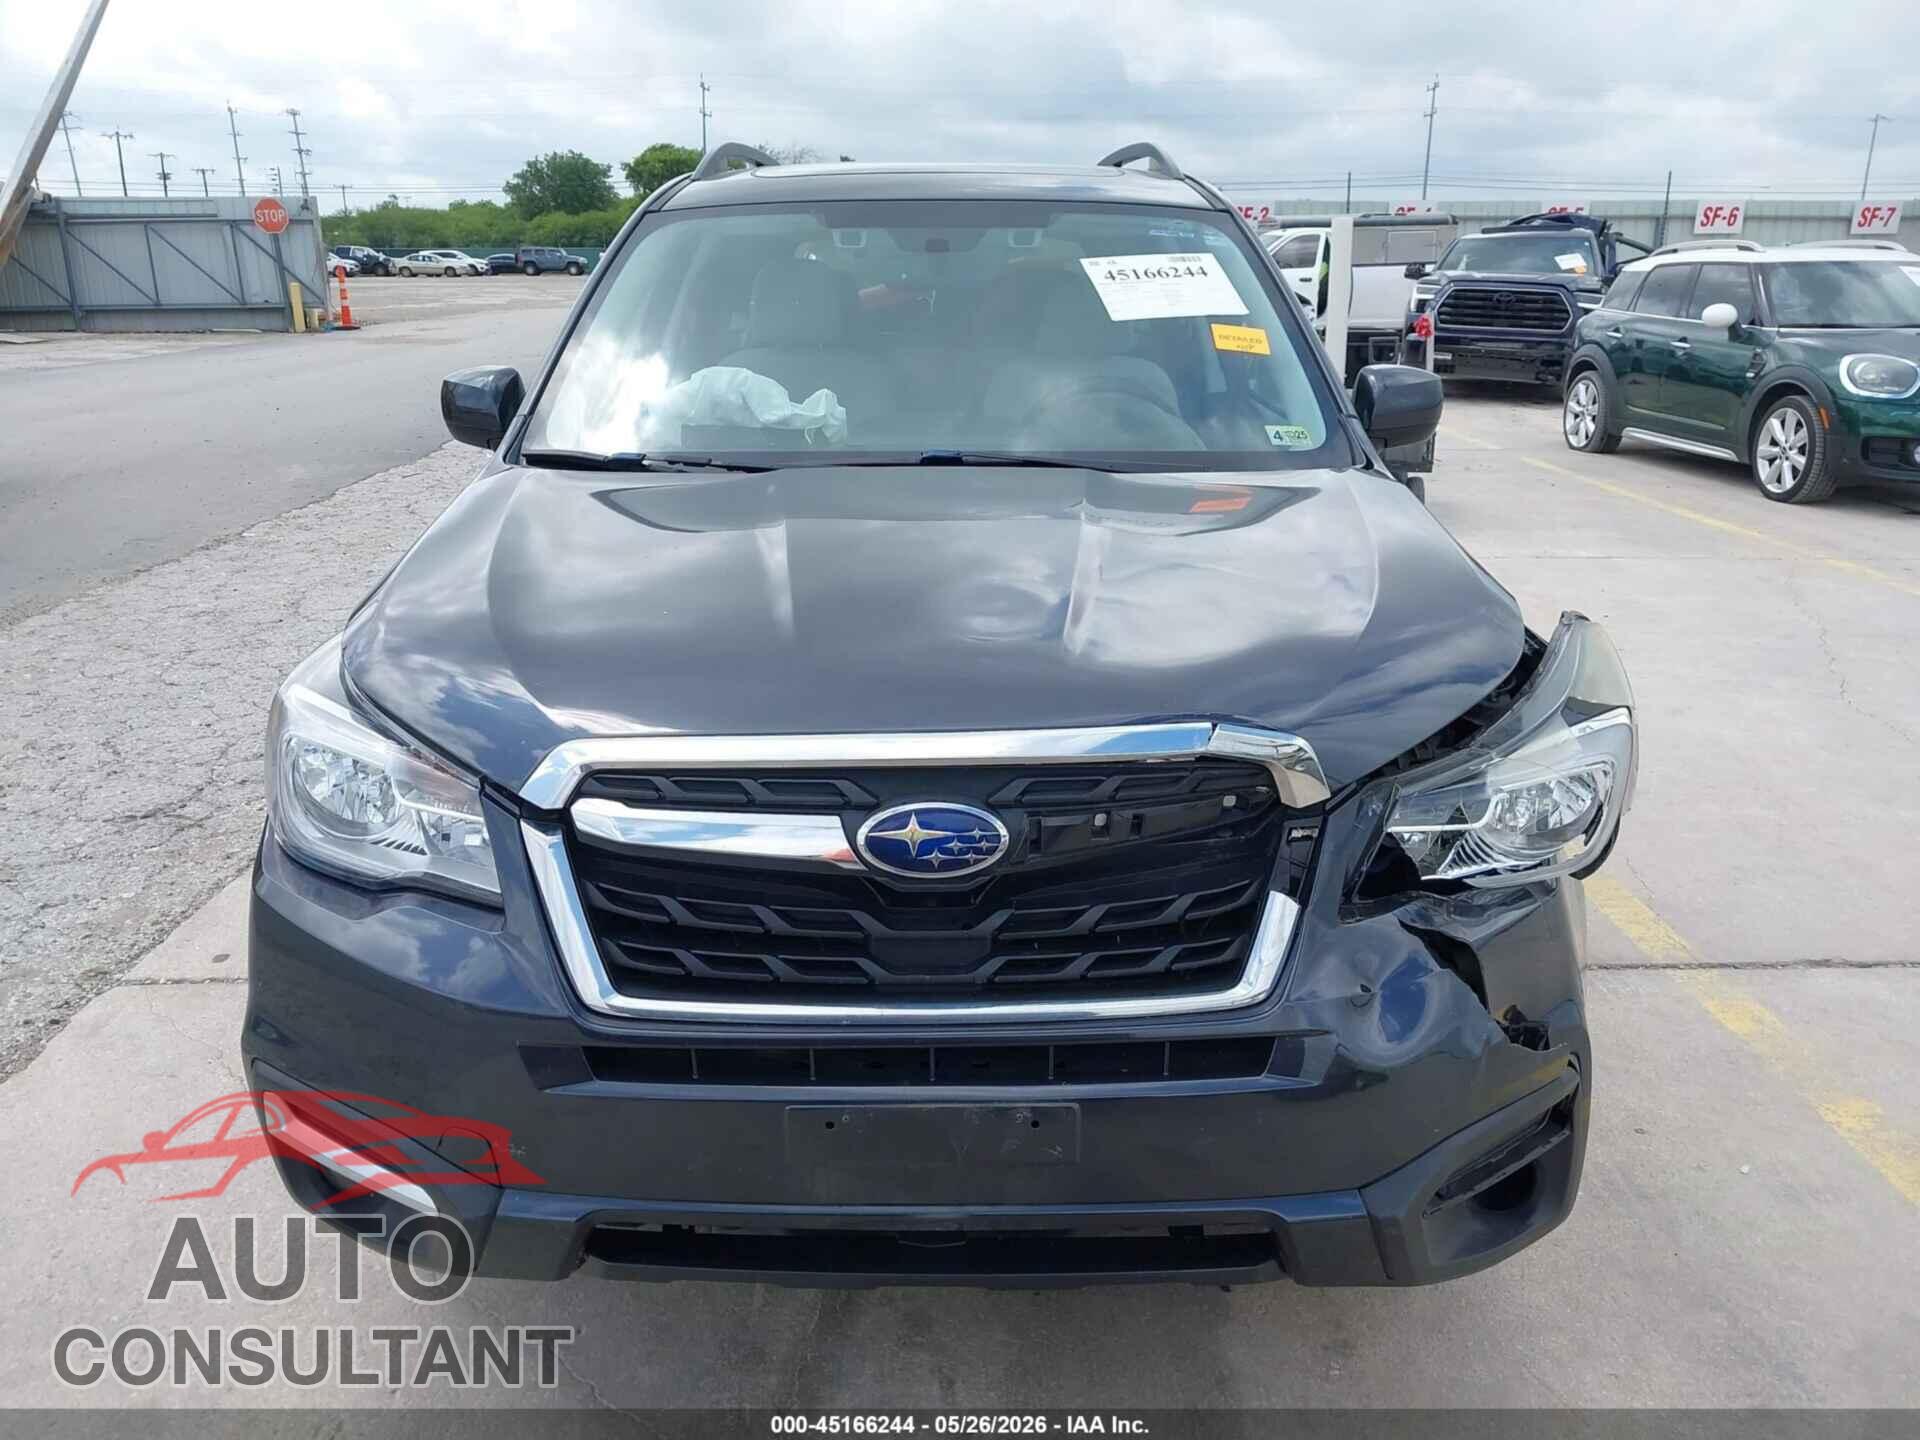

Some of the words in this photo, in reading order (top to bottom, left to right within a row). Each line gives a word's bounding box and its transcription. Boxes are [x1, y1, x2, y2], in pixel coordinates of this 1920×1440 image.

[255, 209, 285, 222] STOP
[1700, 206, 1740, 227] SF-6
[1857, 206, 1897, 228] SF-7
[1104, 265, 1208, 281] 45166244
[1273, 430, 1284, 441] 4
